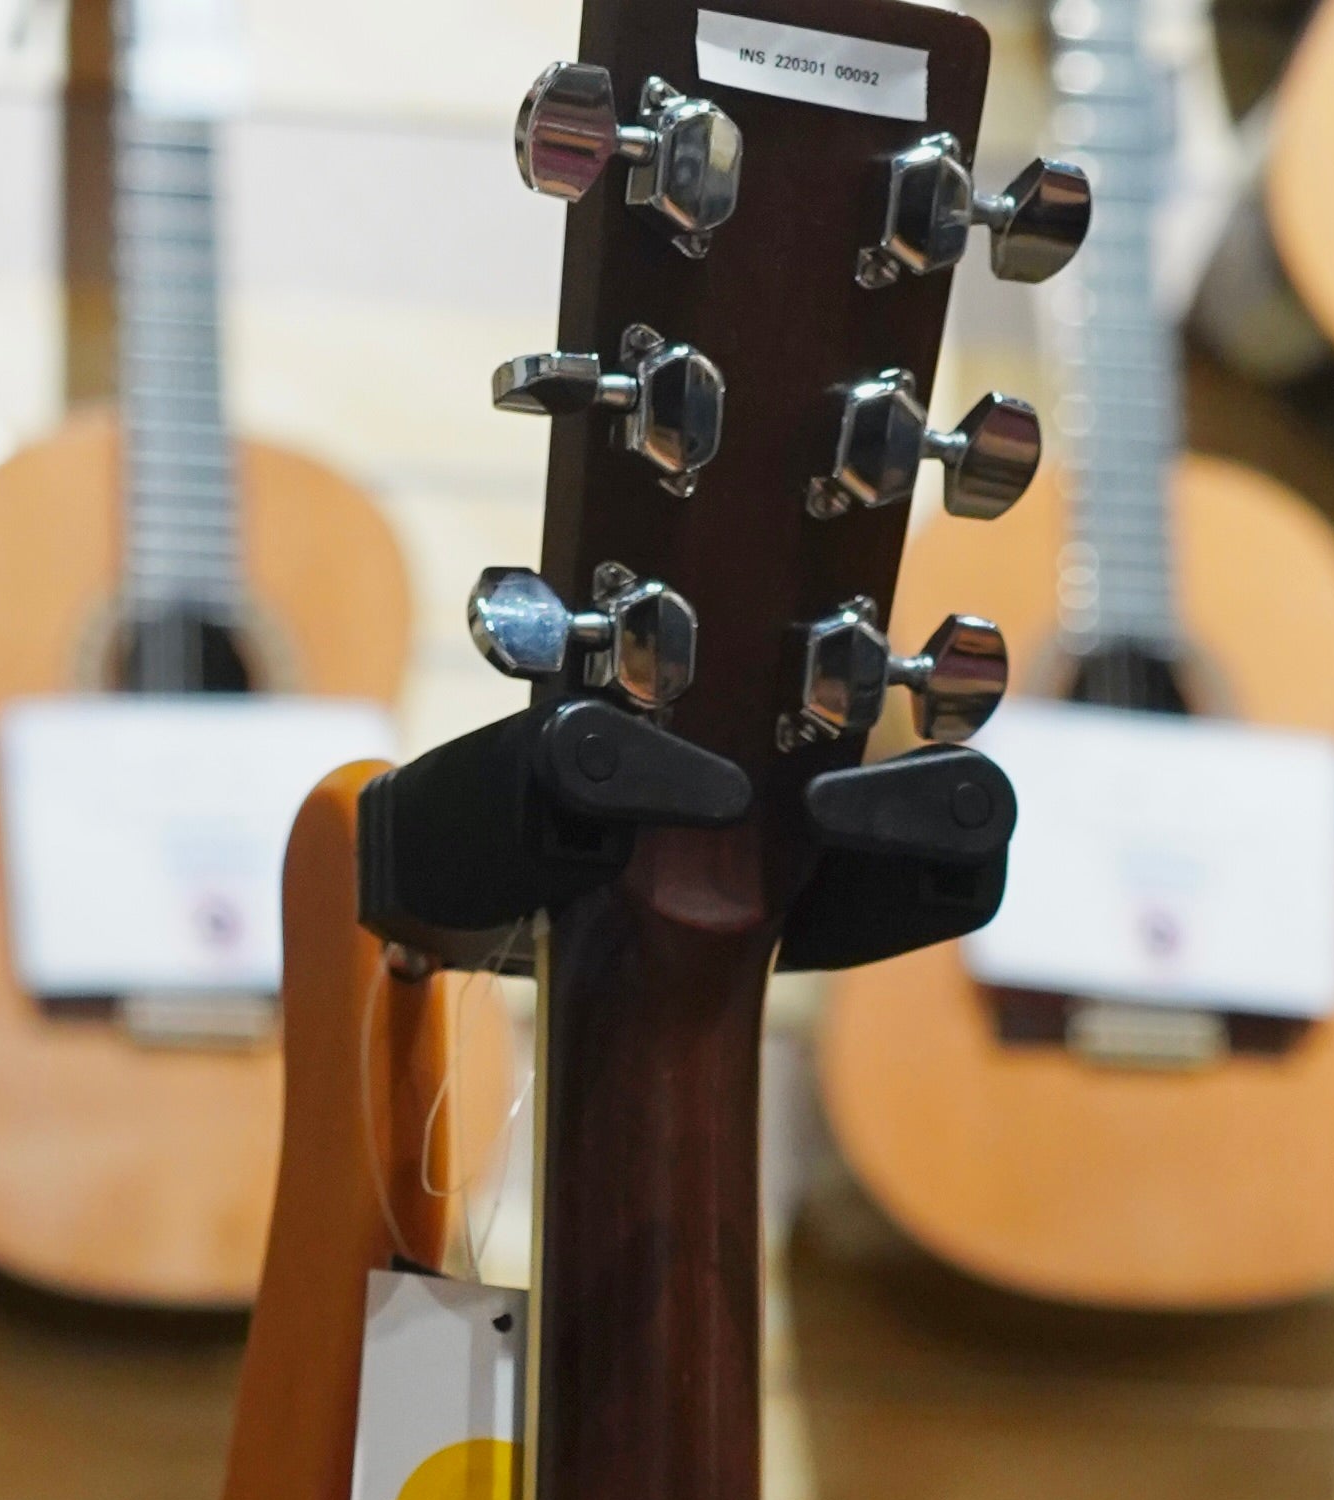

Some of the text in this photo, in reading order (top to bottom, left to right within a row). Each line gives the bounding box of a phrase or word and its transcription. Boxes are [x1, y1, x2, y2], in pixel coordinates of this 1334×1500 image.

[739, 48, 880, 86] INS 220301 00092
